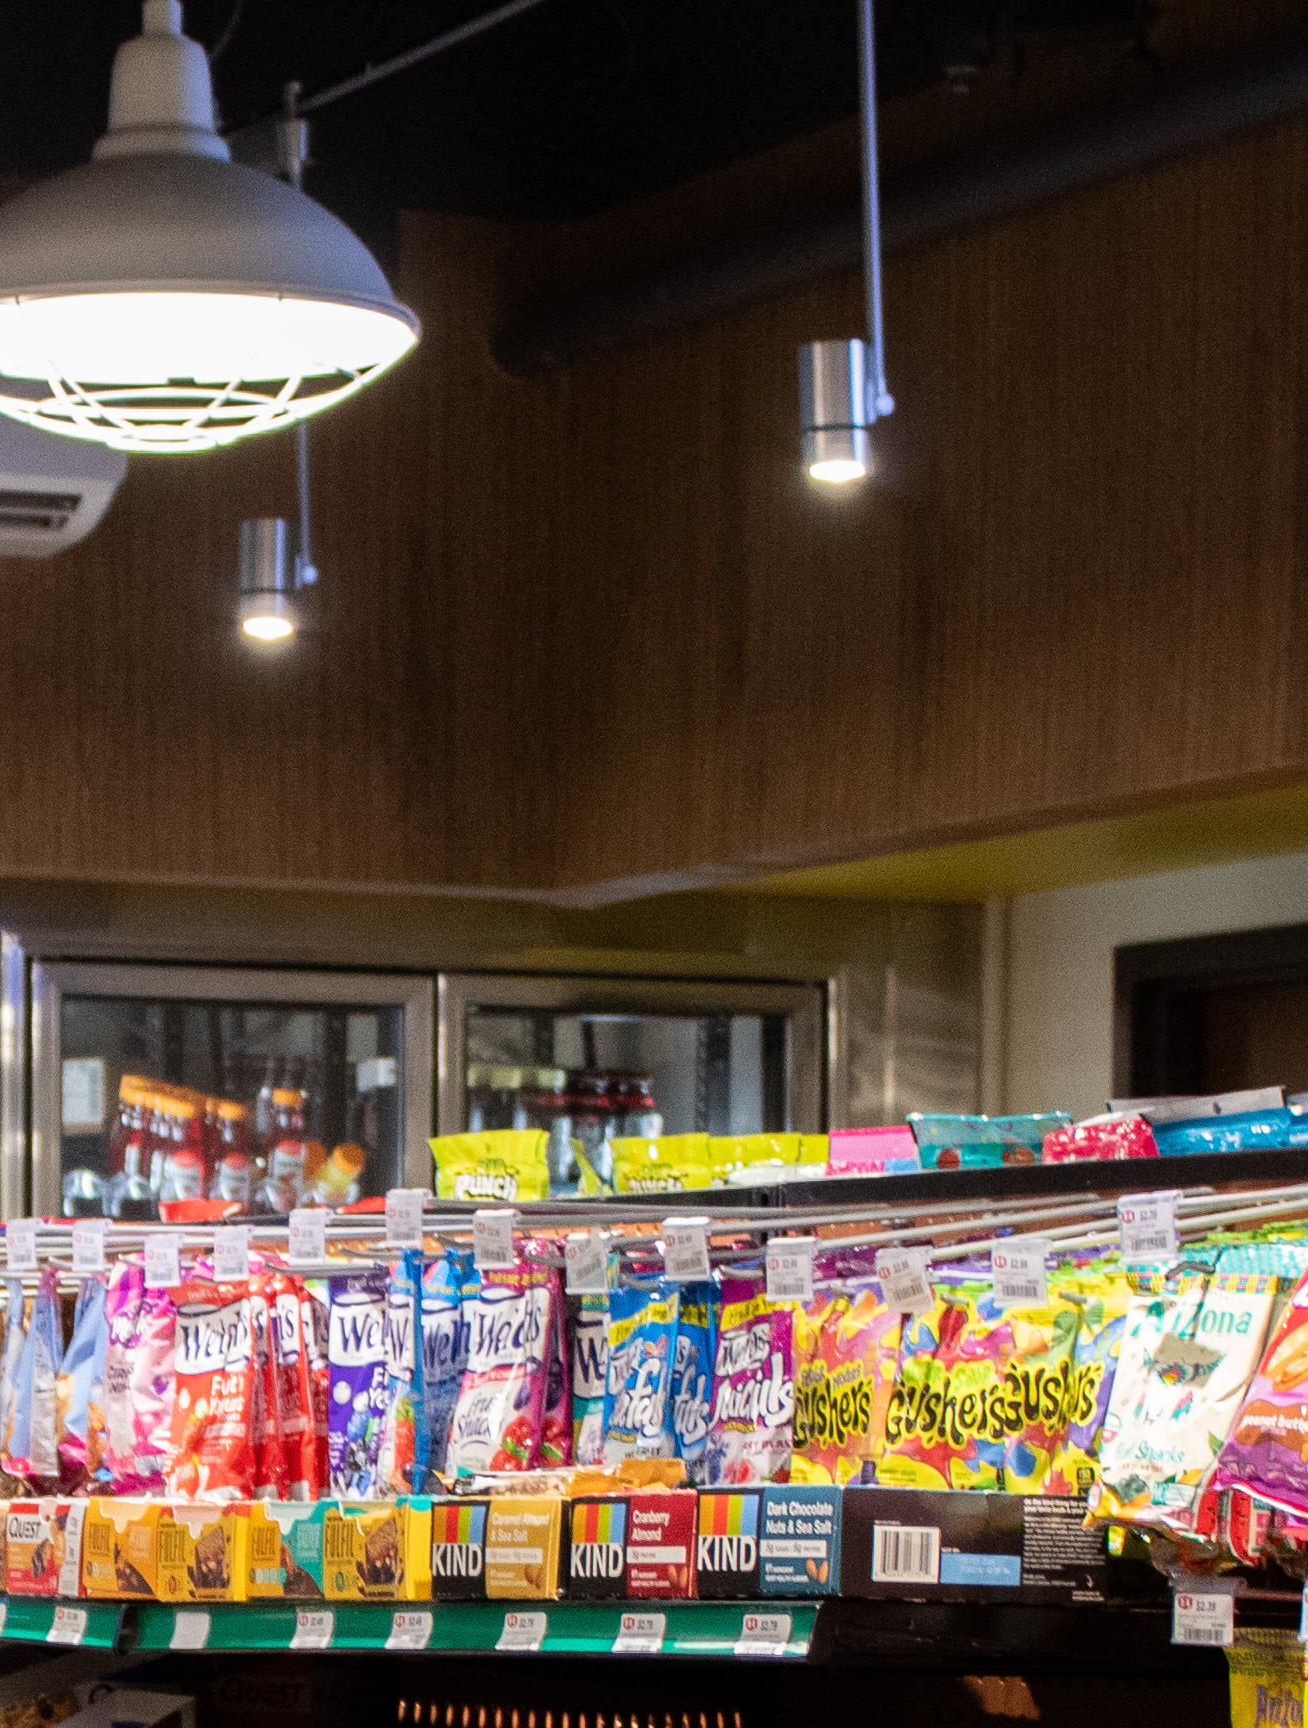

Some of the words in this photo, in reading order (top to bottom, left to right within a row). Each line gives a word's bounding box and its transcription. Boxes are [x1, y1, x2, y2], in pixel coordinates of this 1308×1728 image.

[887, 1376, 1007, 1445] Gushers
[766, 1501, 787, 1517] Dark
[788, 1501, 834, 1517] Chocolate
[632, 1527, 662, 1542] Almond
[432, 1543, 482, 1578] KIND
[570, 1542, 624, 1578] KIND
[696, 1536, 757, 1572] KIND
